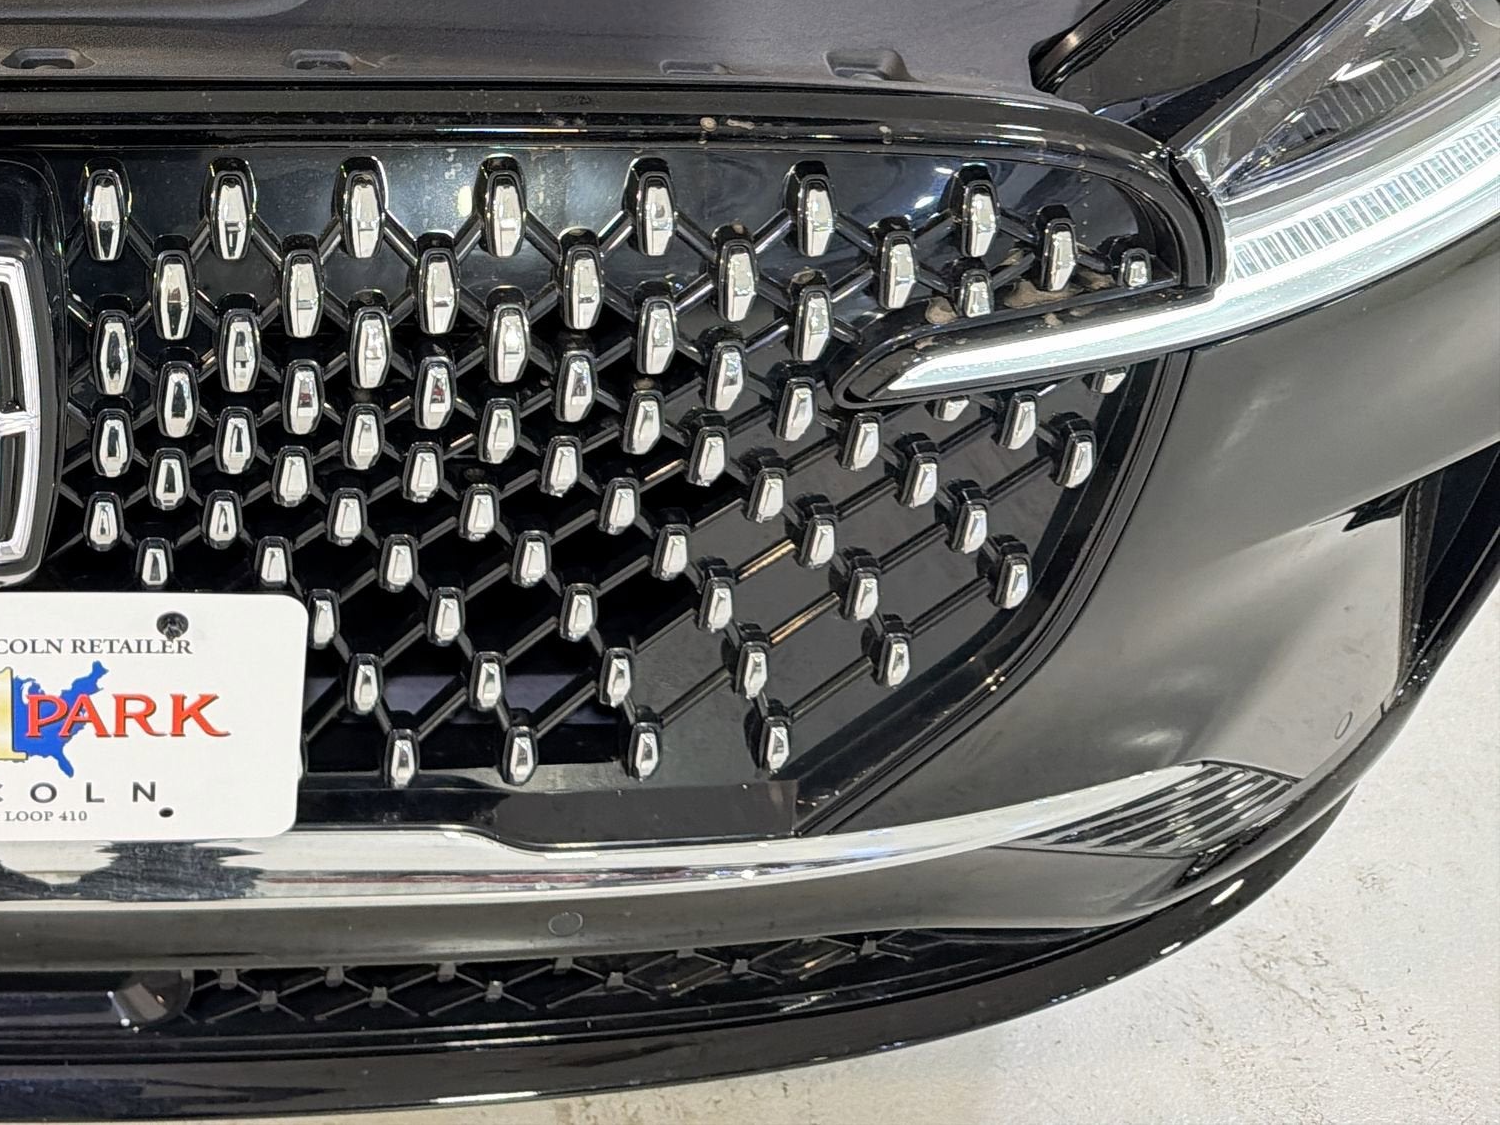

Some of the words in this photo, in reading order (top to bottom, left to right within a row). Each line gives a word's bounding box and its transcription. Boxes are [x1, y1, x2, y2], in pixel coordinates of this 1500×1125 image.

[70, 639, 193, 655] RETAILER
[26, 693, 231, 738] PARK
[5, 811, 54, 822] LOOP
[58, 811, 88, 822] 410
